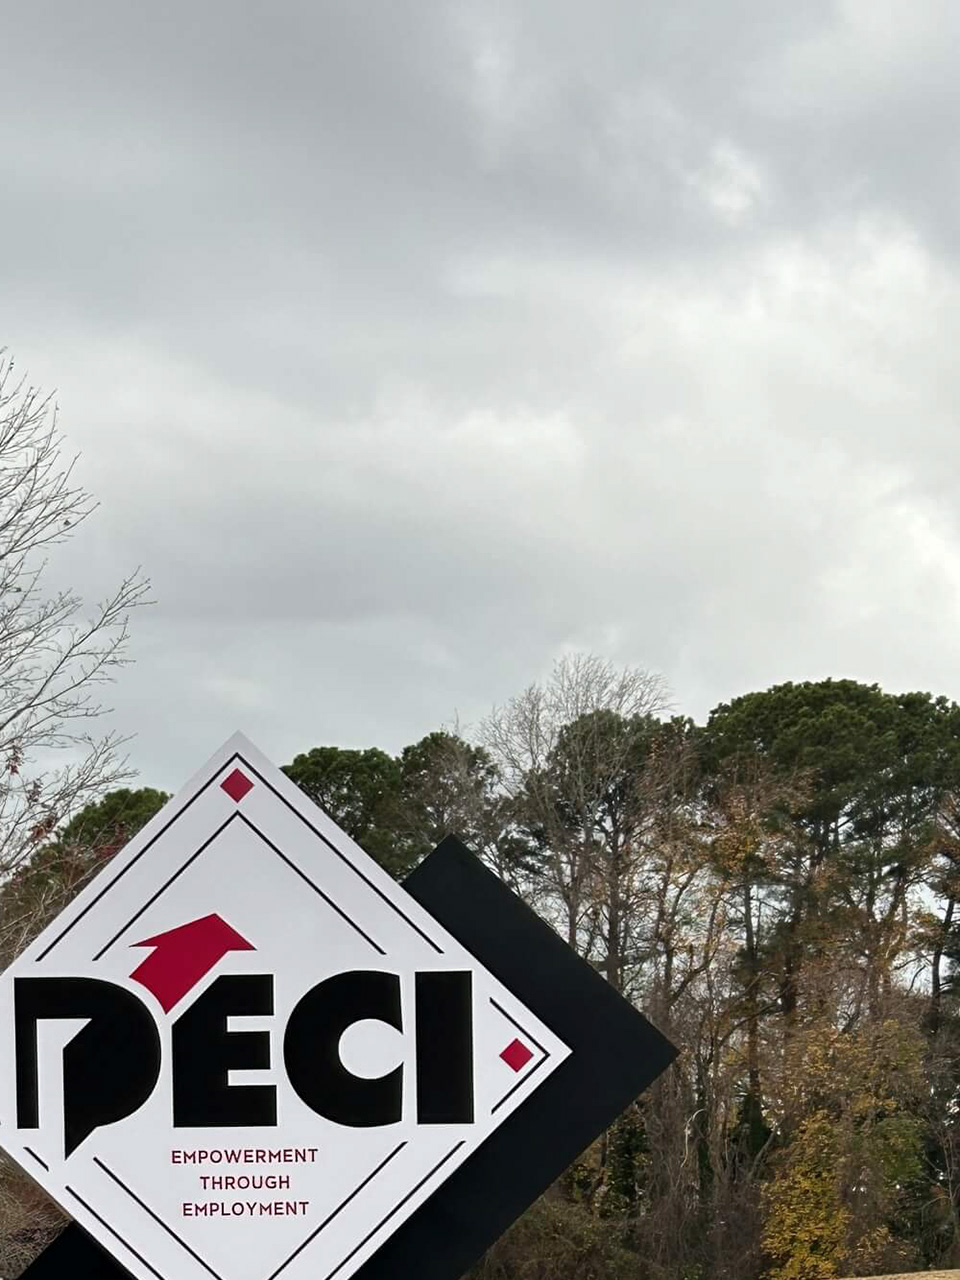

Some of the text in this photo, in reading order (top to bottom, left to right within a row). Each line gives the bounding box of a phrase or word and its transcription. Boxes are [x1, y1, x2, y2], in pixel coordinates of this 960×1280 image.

[14, 970, 475, 1160] PECI
[171, 1149, 319, 1164] EMPOWERMENT
[199, 1175, 290, 1190] THROUGH
[182, 1201, 310, 1217] EMPLOYMENT
